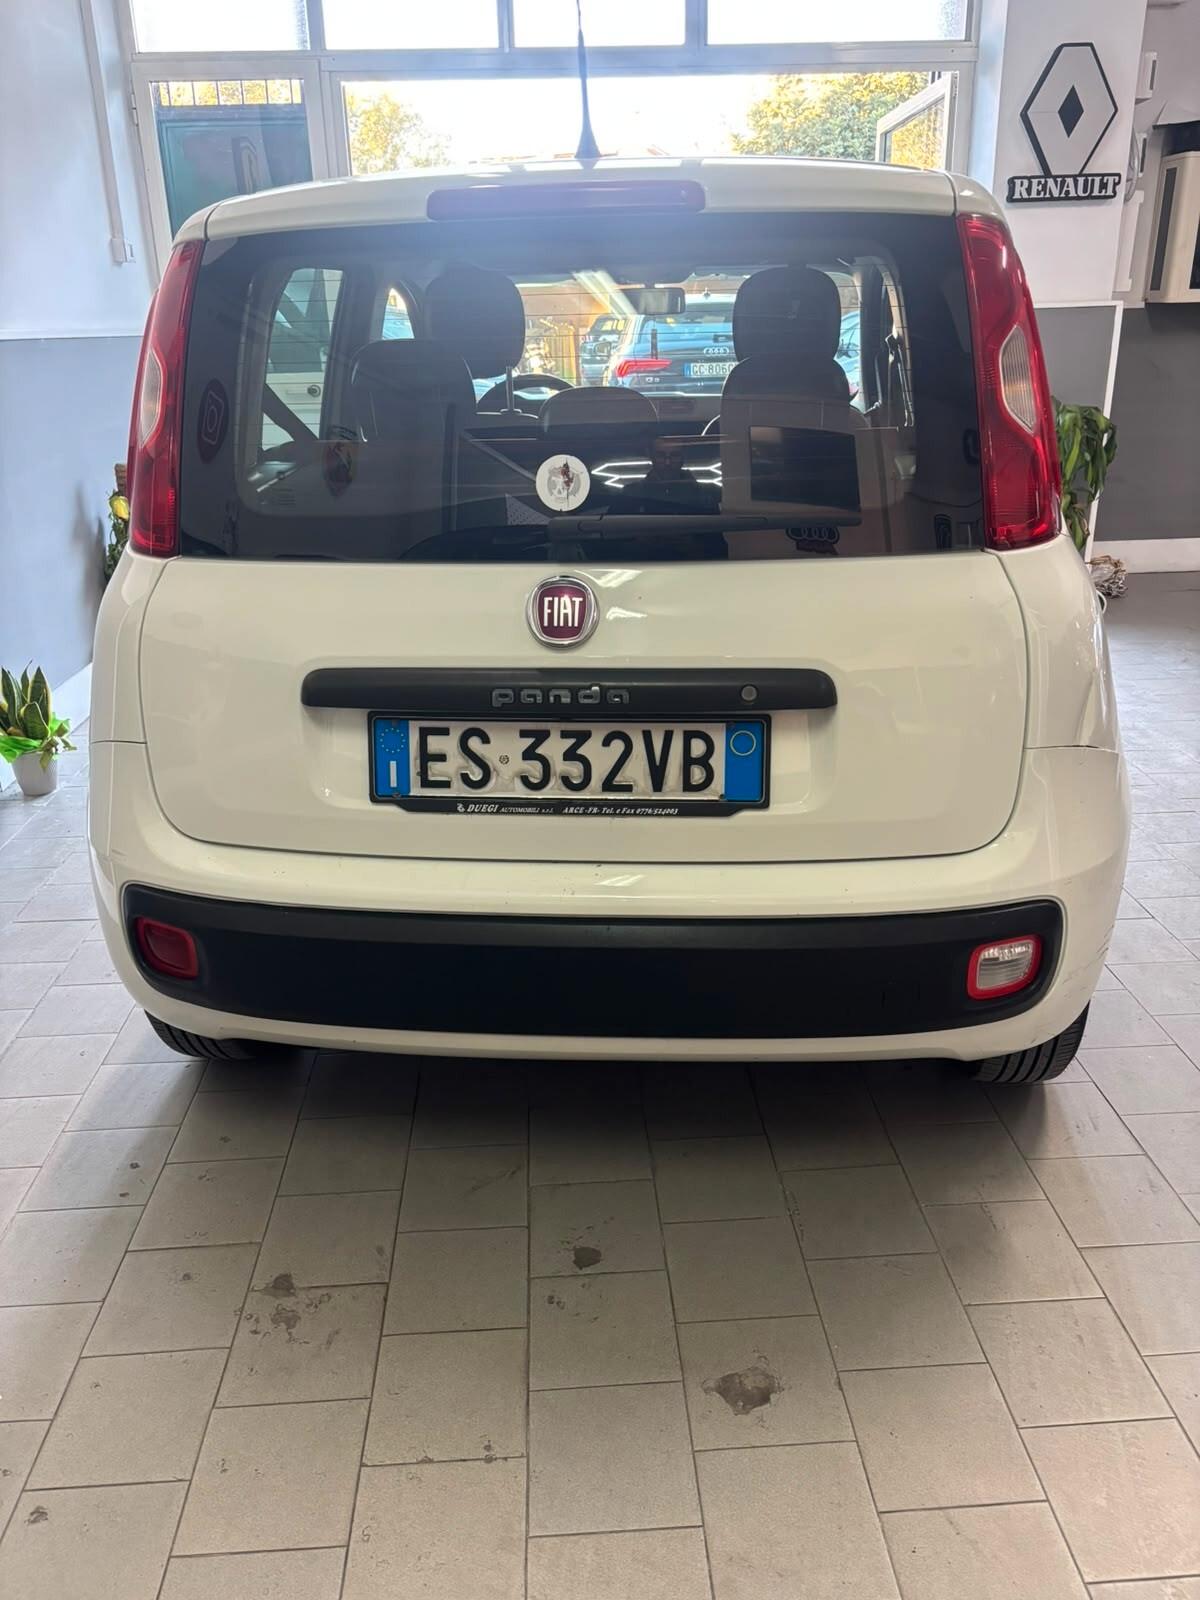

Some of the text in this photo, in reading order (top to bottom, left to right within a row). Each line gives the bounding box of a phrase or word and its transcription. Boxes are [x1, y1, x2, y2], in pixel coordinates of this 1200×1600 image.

[1012, 175, 1119, 199] RENAULT
[543, 595, 584, 628] FIAT
[491, 685, 630, 707] panda
[466, 804, 500, 813] DUEGI
